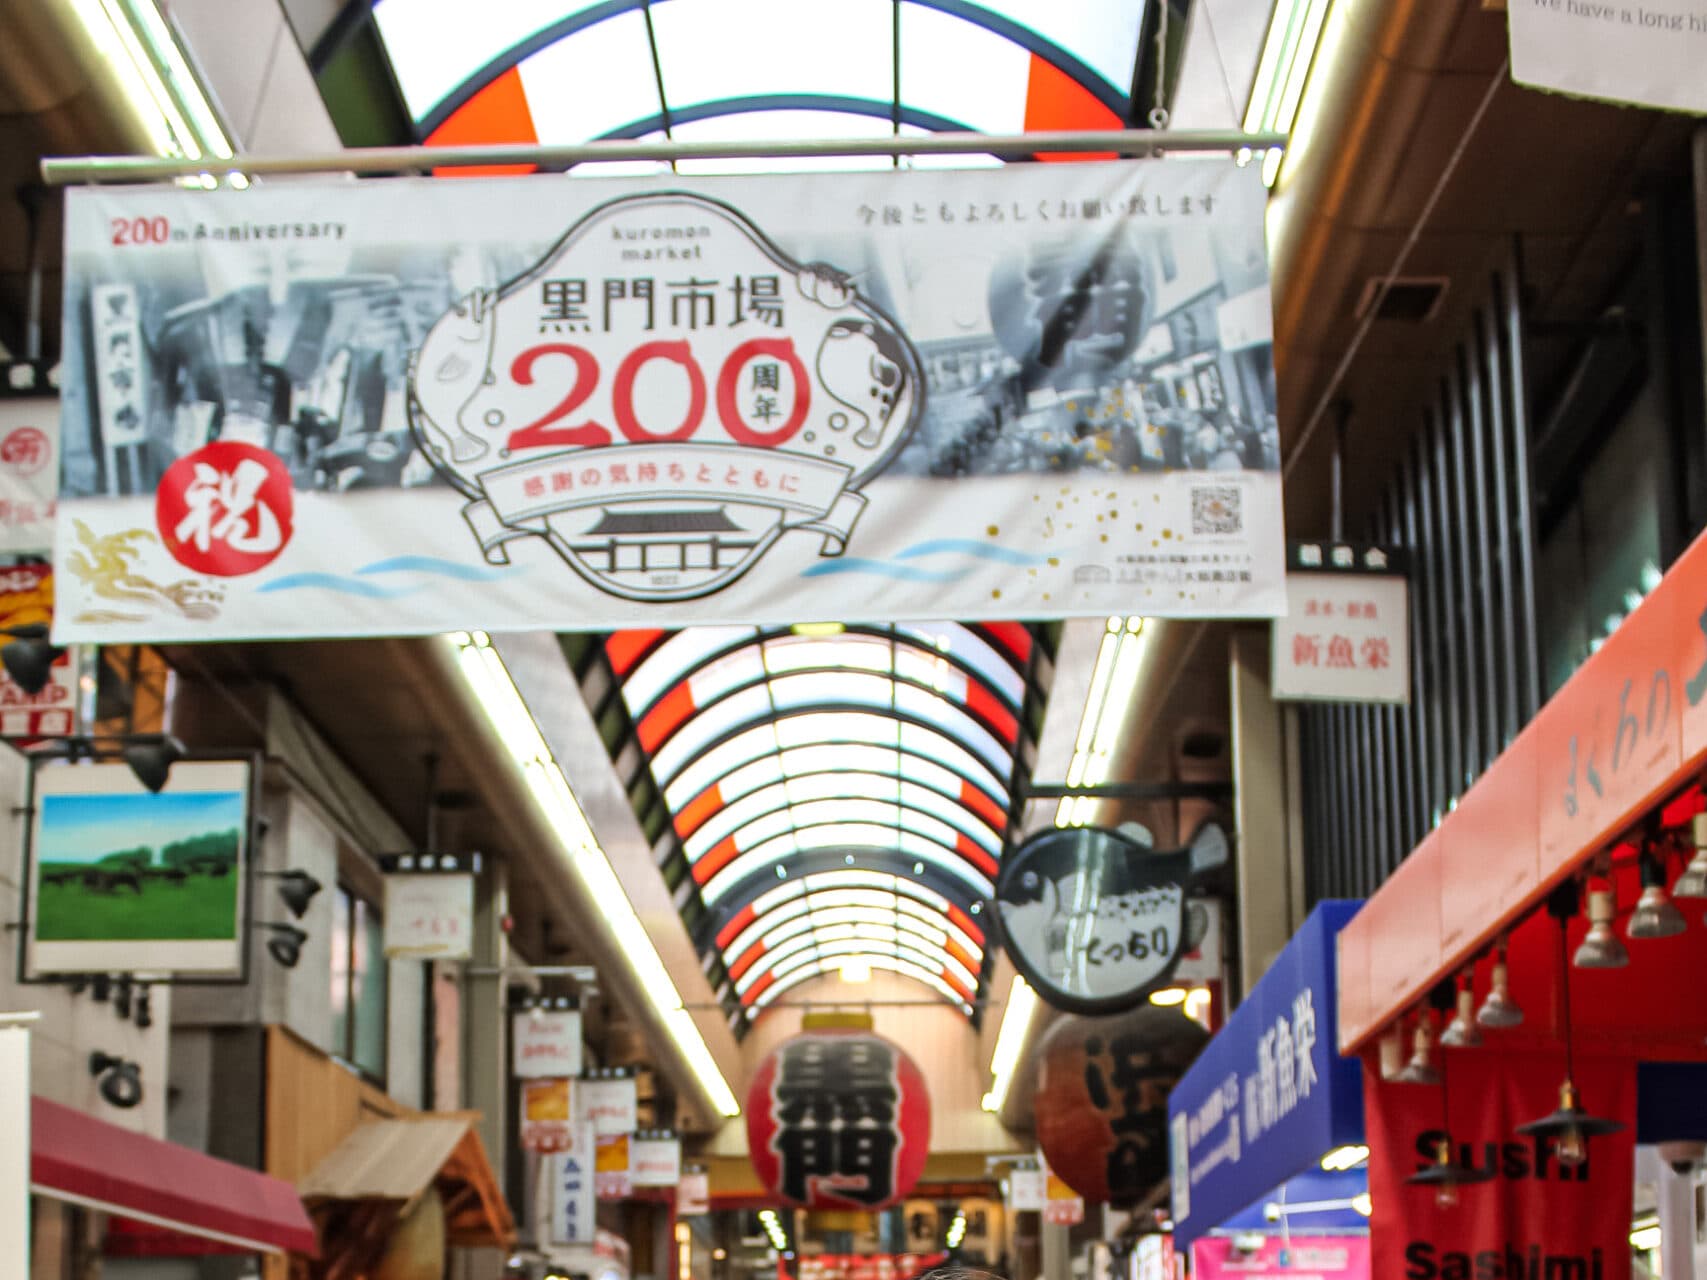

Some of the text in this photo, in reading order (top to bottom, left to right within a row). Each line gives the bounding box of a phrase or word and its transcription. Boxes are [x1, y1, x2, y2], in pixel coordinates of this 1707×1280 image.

[1567, 0, 1616, 20] have
[1621, 8, 1633, 24] a
[1639, 7, 1683, 31] long
[194, 222, 346, 241] Anniversary
[621, 245, 703, 262] market
[538, 274, 785, 333] 黒門市場
[507, 337, 811, 450] 200
[751, 363, 782, 425] 周年
[175, 458, 283, 554] 祝
[522, 462, 801, 499] 感謝の気持ちとともに
[1415, 1130, 1590, 1182] Sushi
